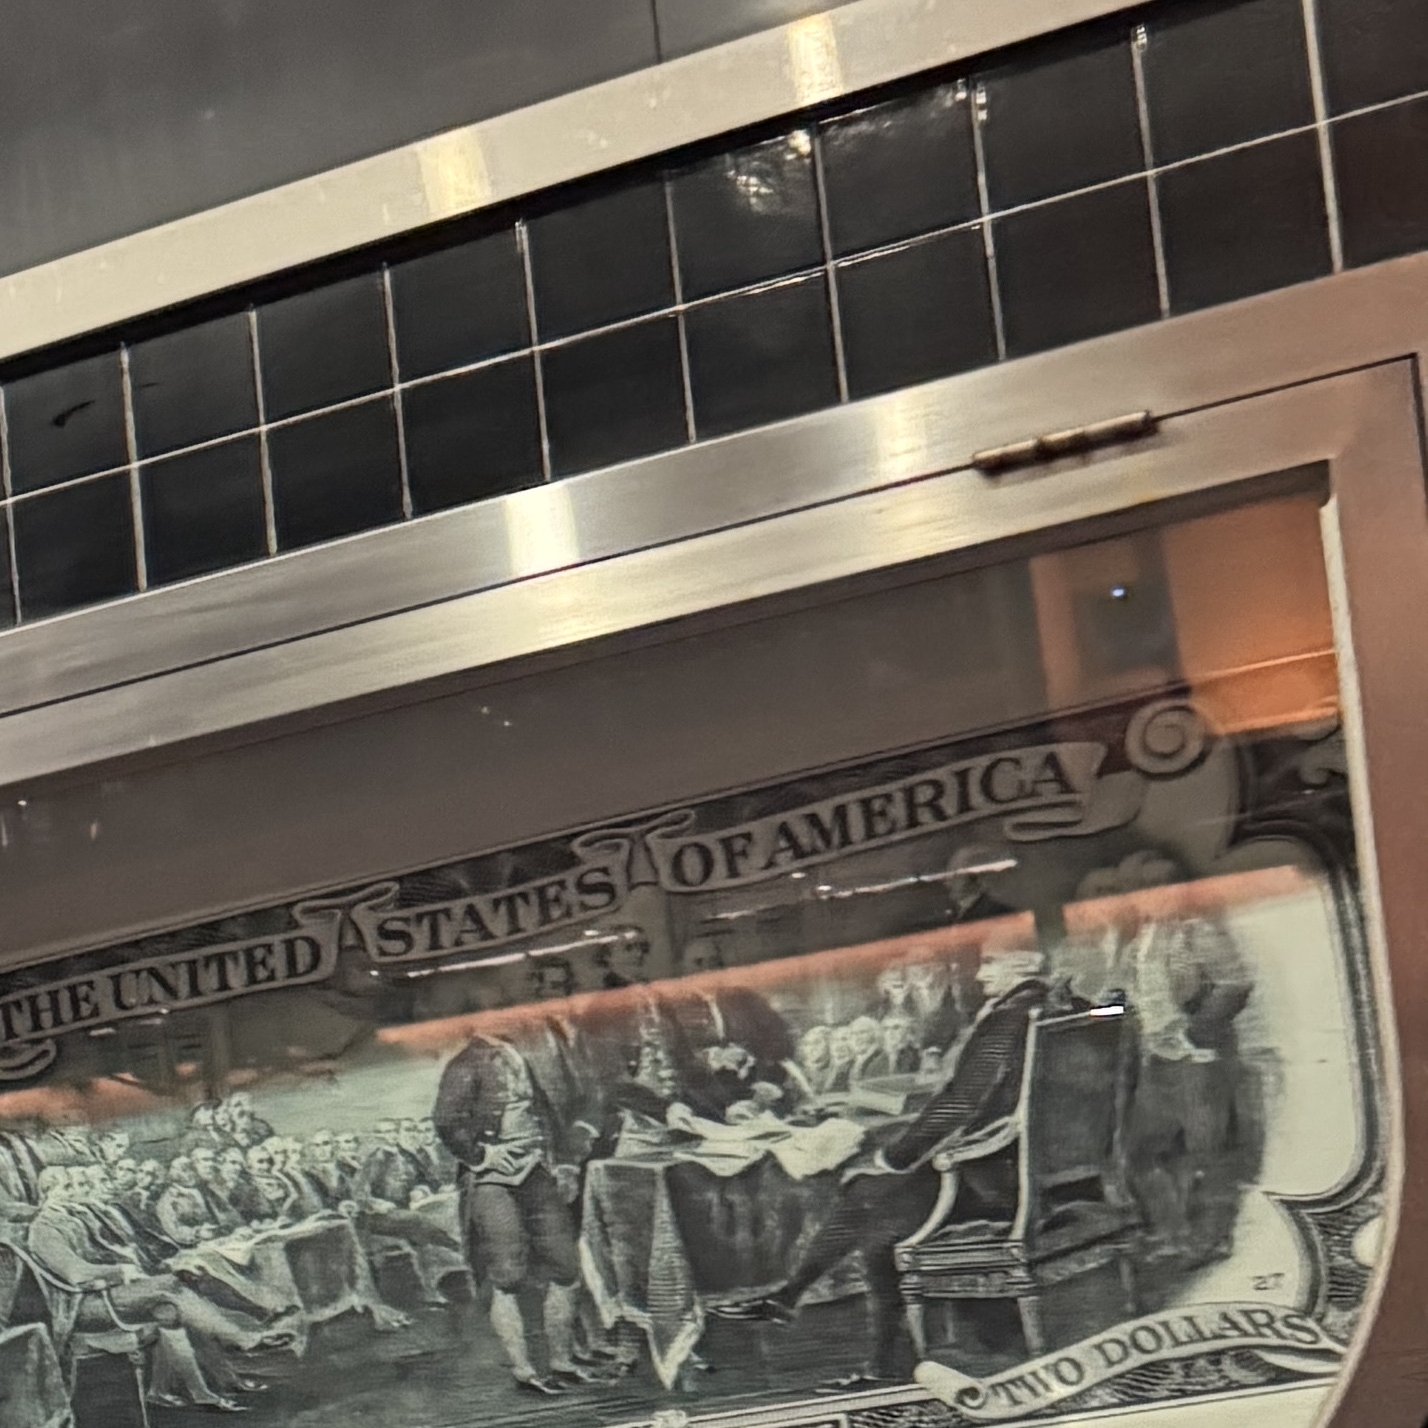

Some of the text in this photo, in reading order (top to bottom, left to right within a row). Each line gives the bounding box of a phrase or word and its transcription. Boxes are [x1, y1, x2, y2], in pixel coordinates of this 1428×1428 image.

[671, 751, 1082, 888] OF AMERICA
[376, 865, 618, 958] STATES
[108, 933, 323, 1013] UNITED
[989, 1307, 1322, 1406] TWO DOLLARS
